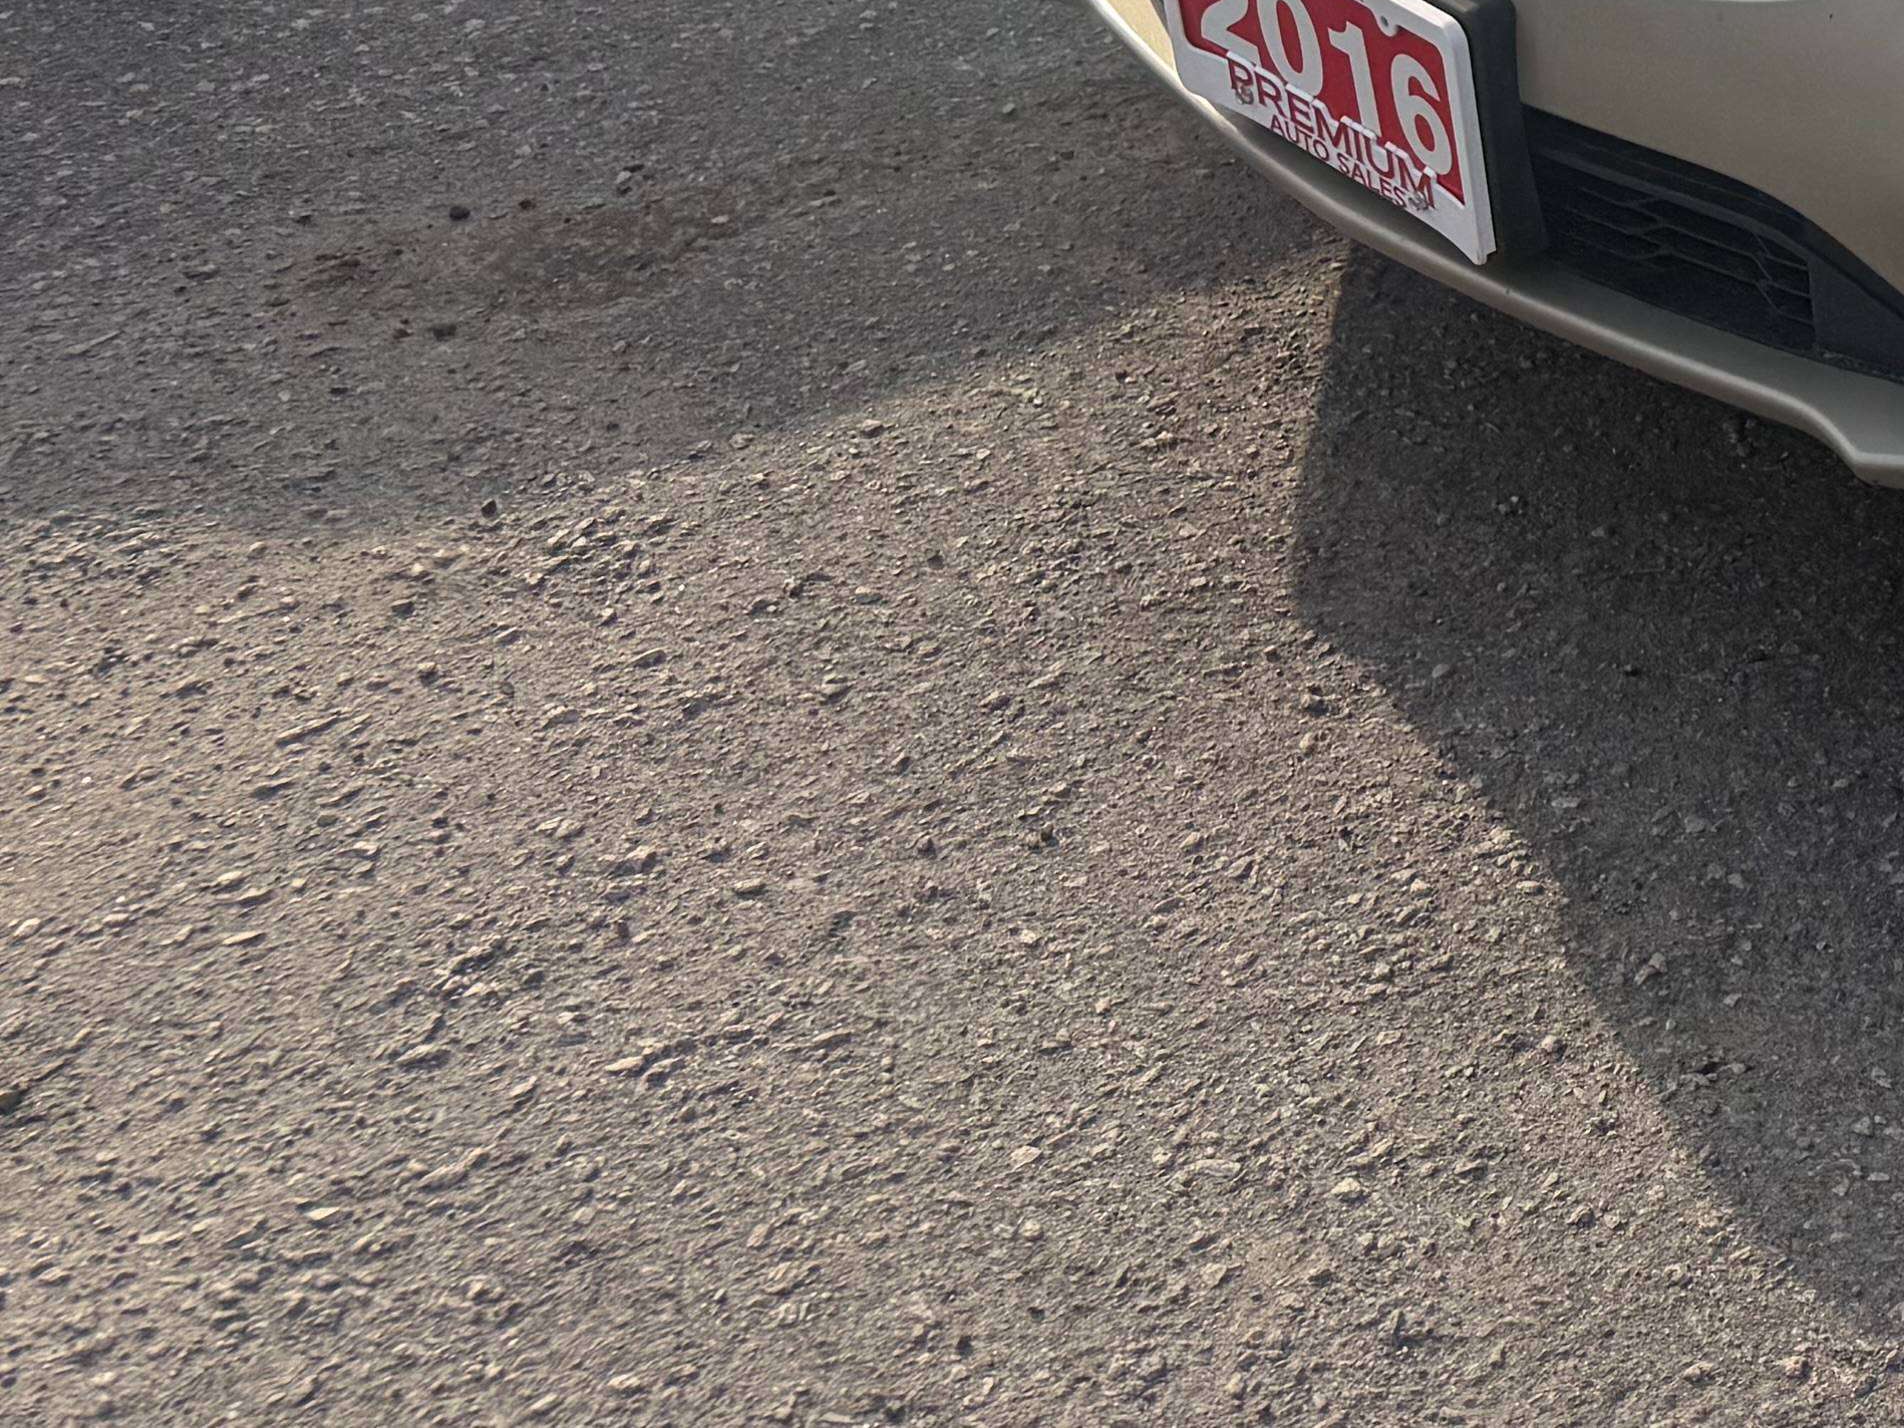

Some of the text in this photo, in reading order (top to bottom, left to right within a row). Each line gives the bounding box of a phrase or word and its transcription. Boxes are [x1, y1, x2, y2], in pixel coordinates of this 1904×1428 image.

[1227, 56, 1436, 209] PREMIUM
[1271, 114, 1405, 207] AUTO SALES
